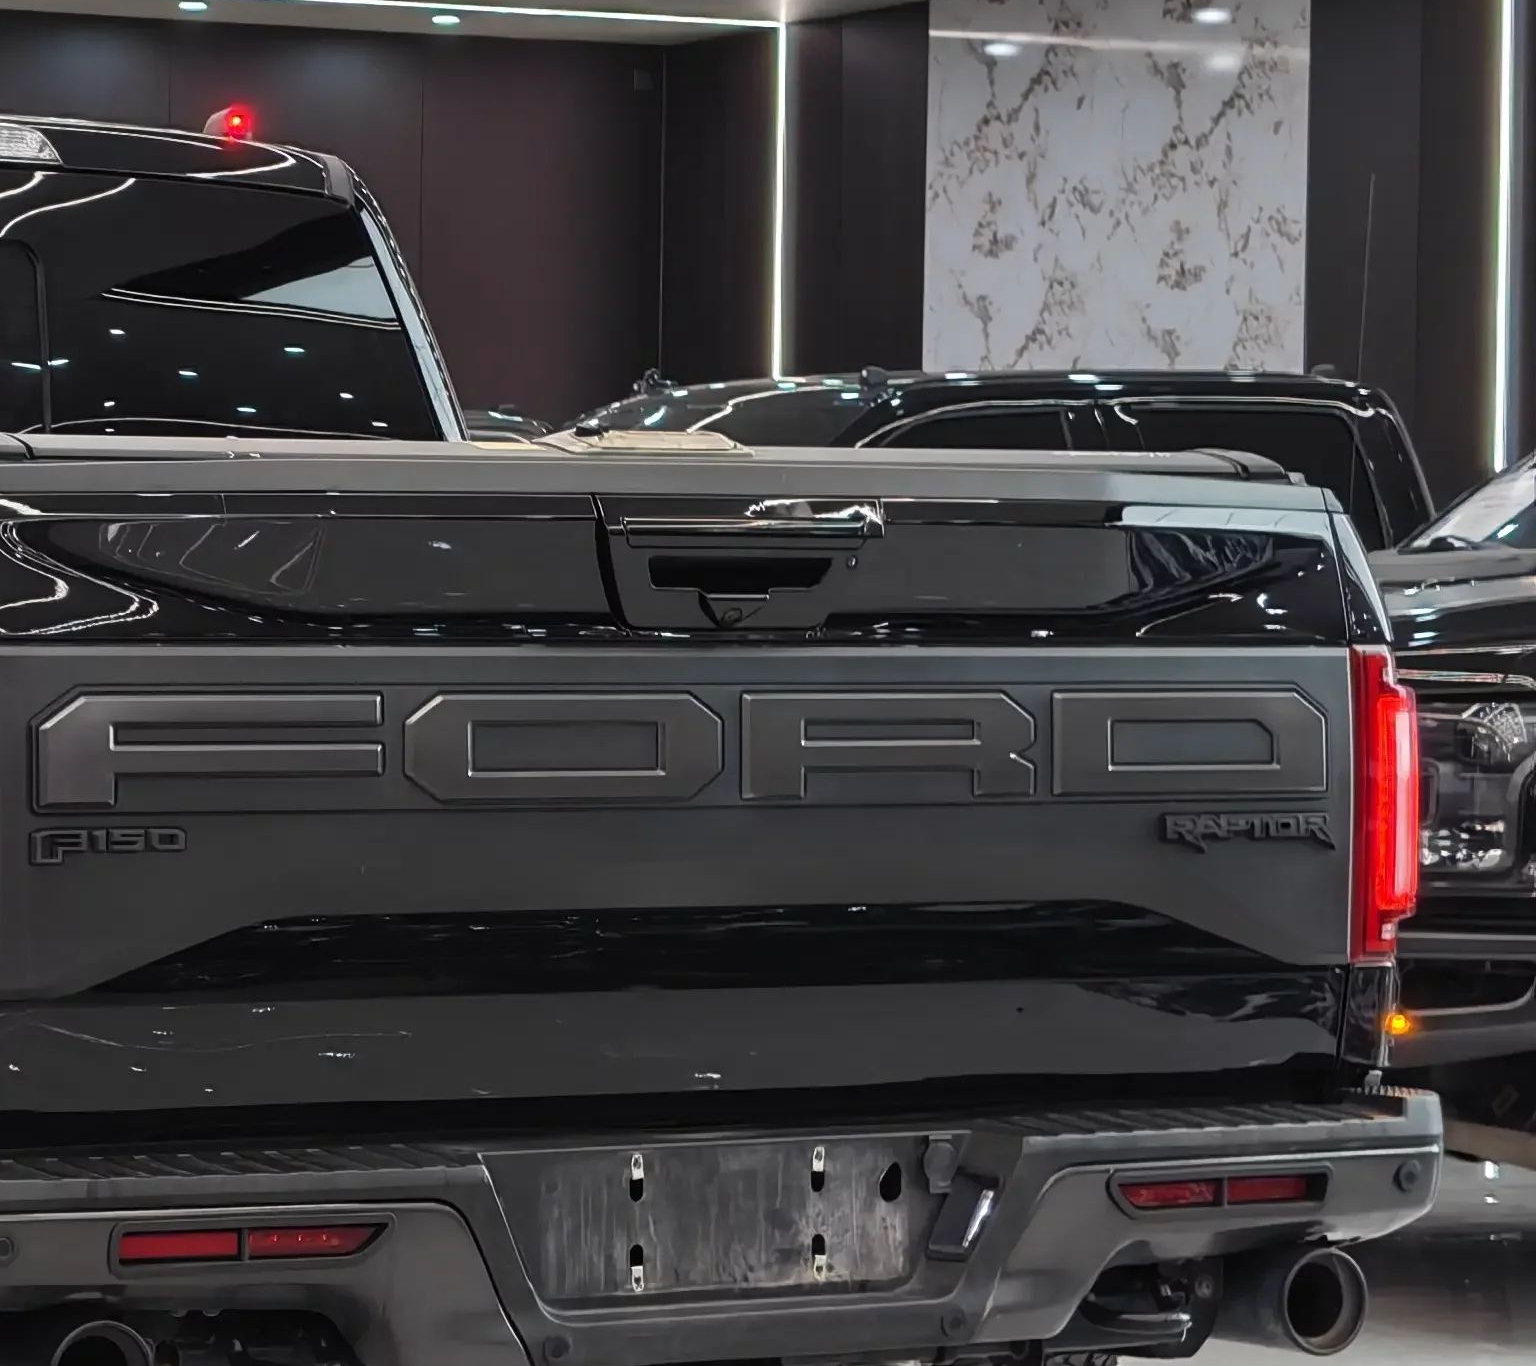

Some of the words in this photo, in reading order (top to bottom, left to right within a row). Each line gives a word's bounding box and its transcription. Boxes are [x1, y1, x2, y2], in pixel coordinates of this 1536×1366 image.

[35, 689, 1328, 807] FORD
[30, 828, 187, 864] F150
[1162, 812, 1336, 853] RAPTOR
